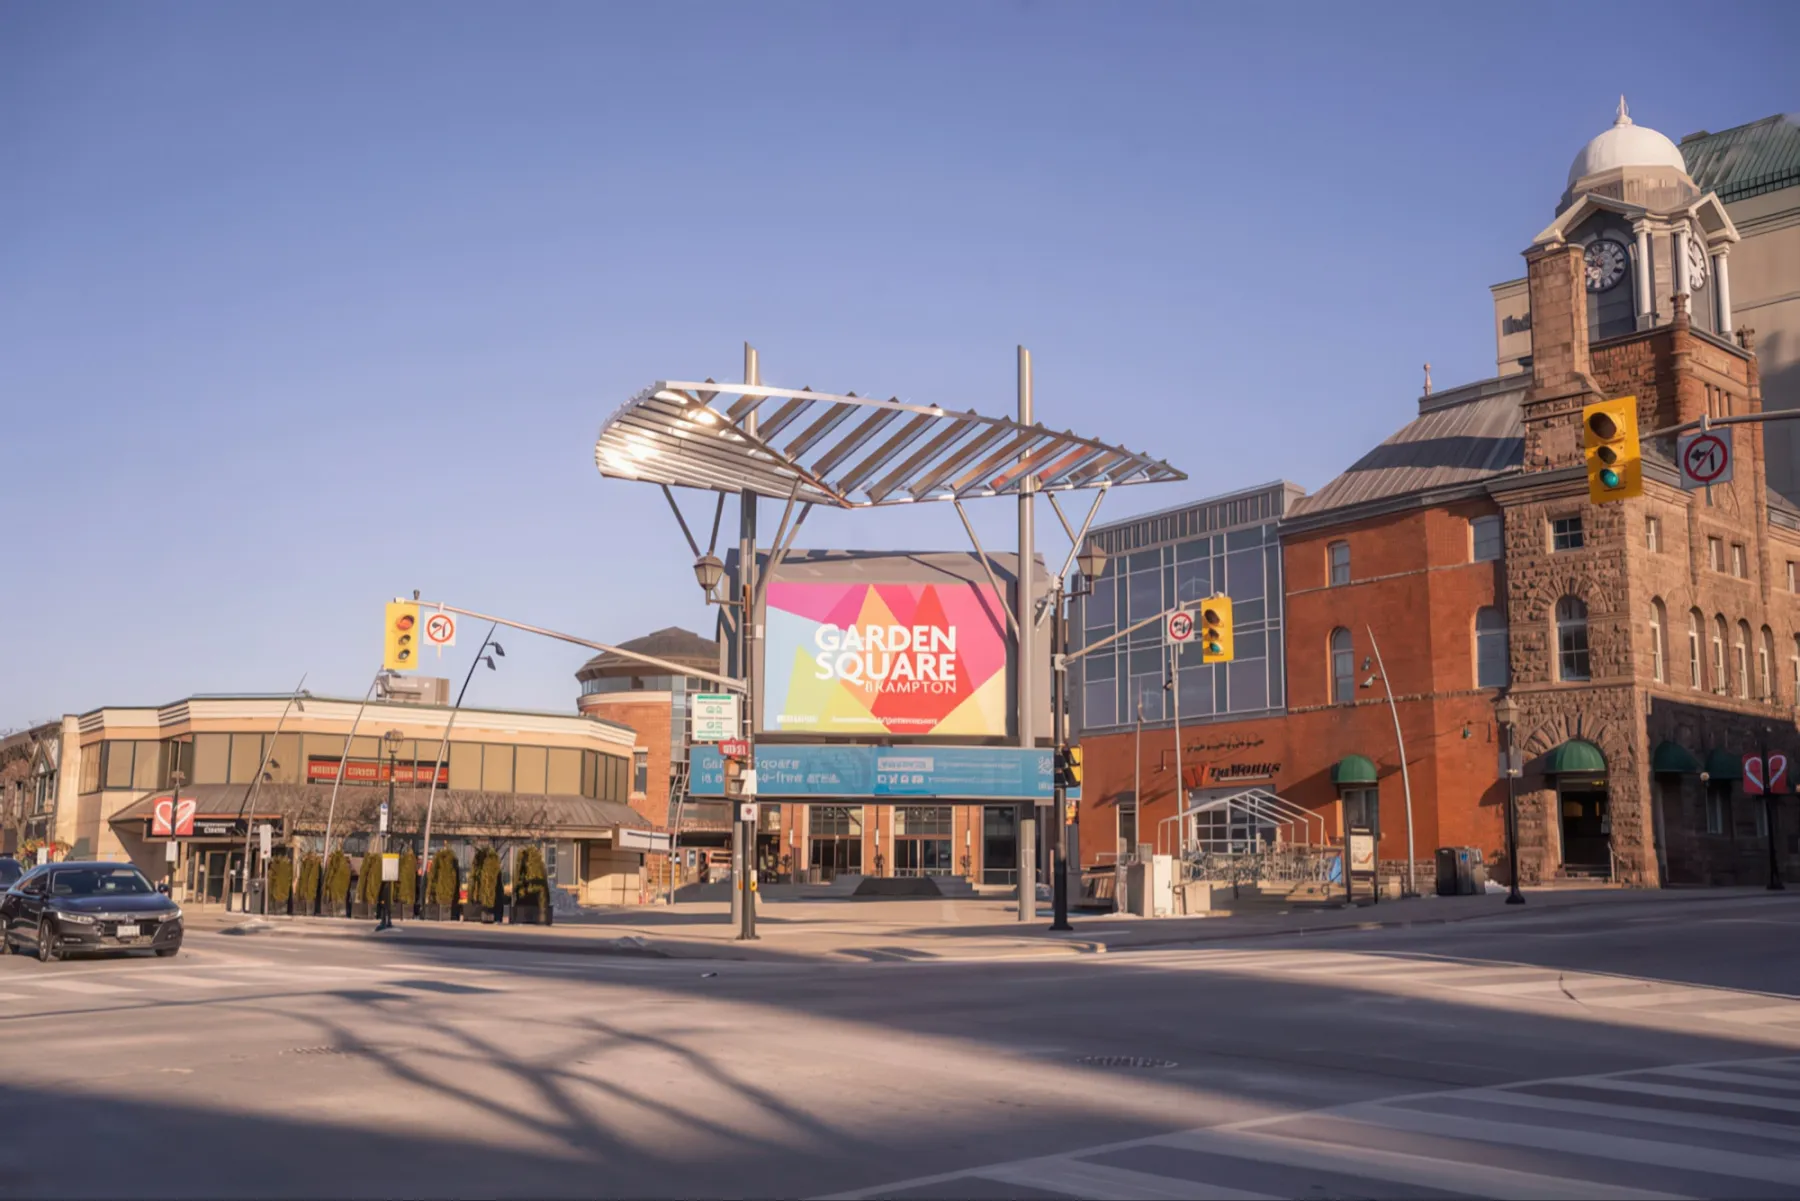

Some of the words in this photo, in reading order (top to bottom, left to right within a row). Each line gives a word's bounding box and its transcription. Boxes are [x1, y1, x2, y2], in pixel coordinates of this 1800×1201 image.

[815, 623, 956, 652] GARDEN
[815, 651, 956, 686] SQUARE
[865, 680, 957, 694] BRAMPTON
